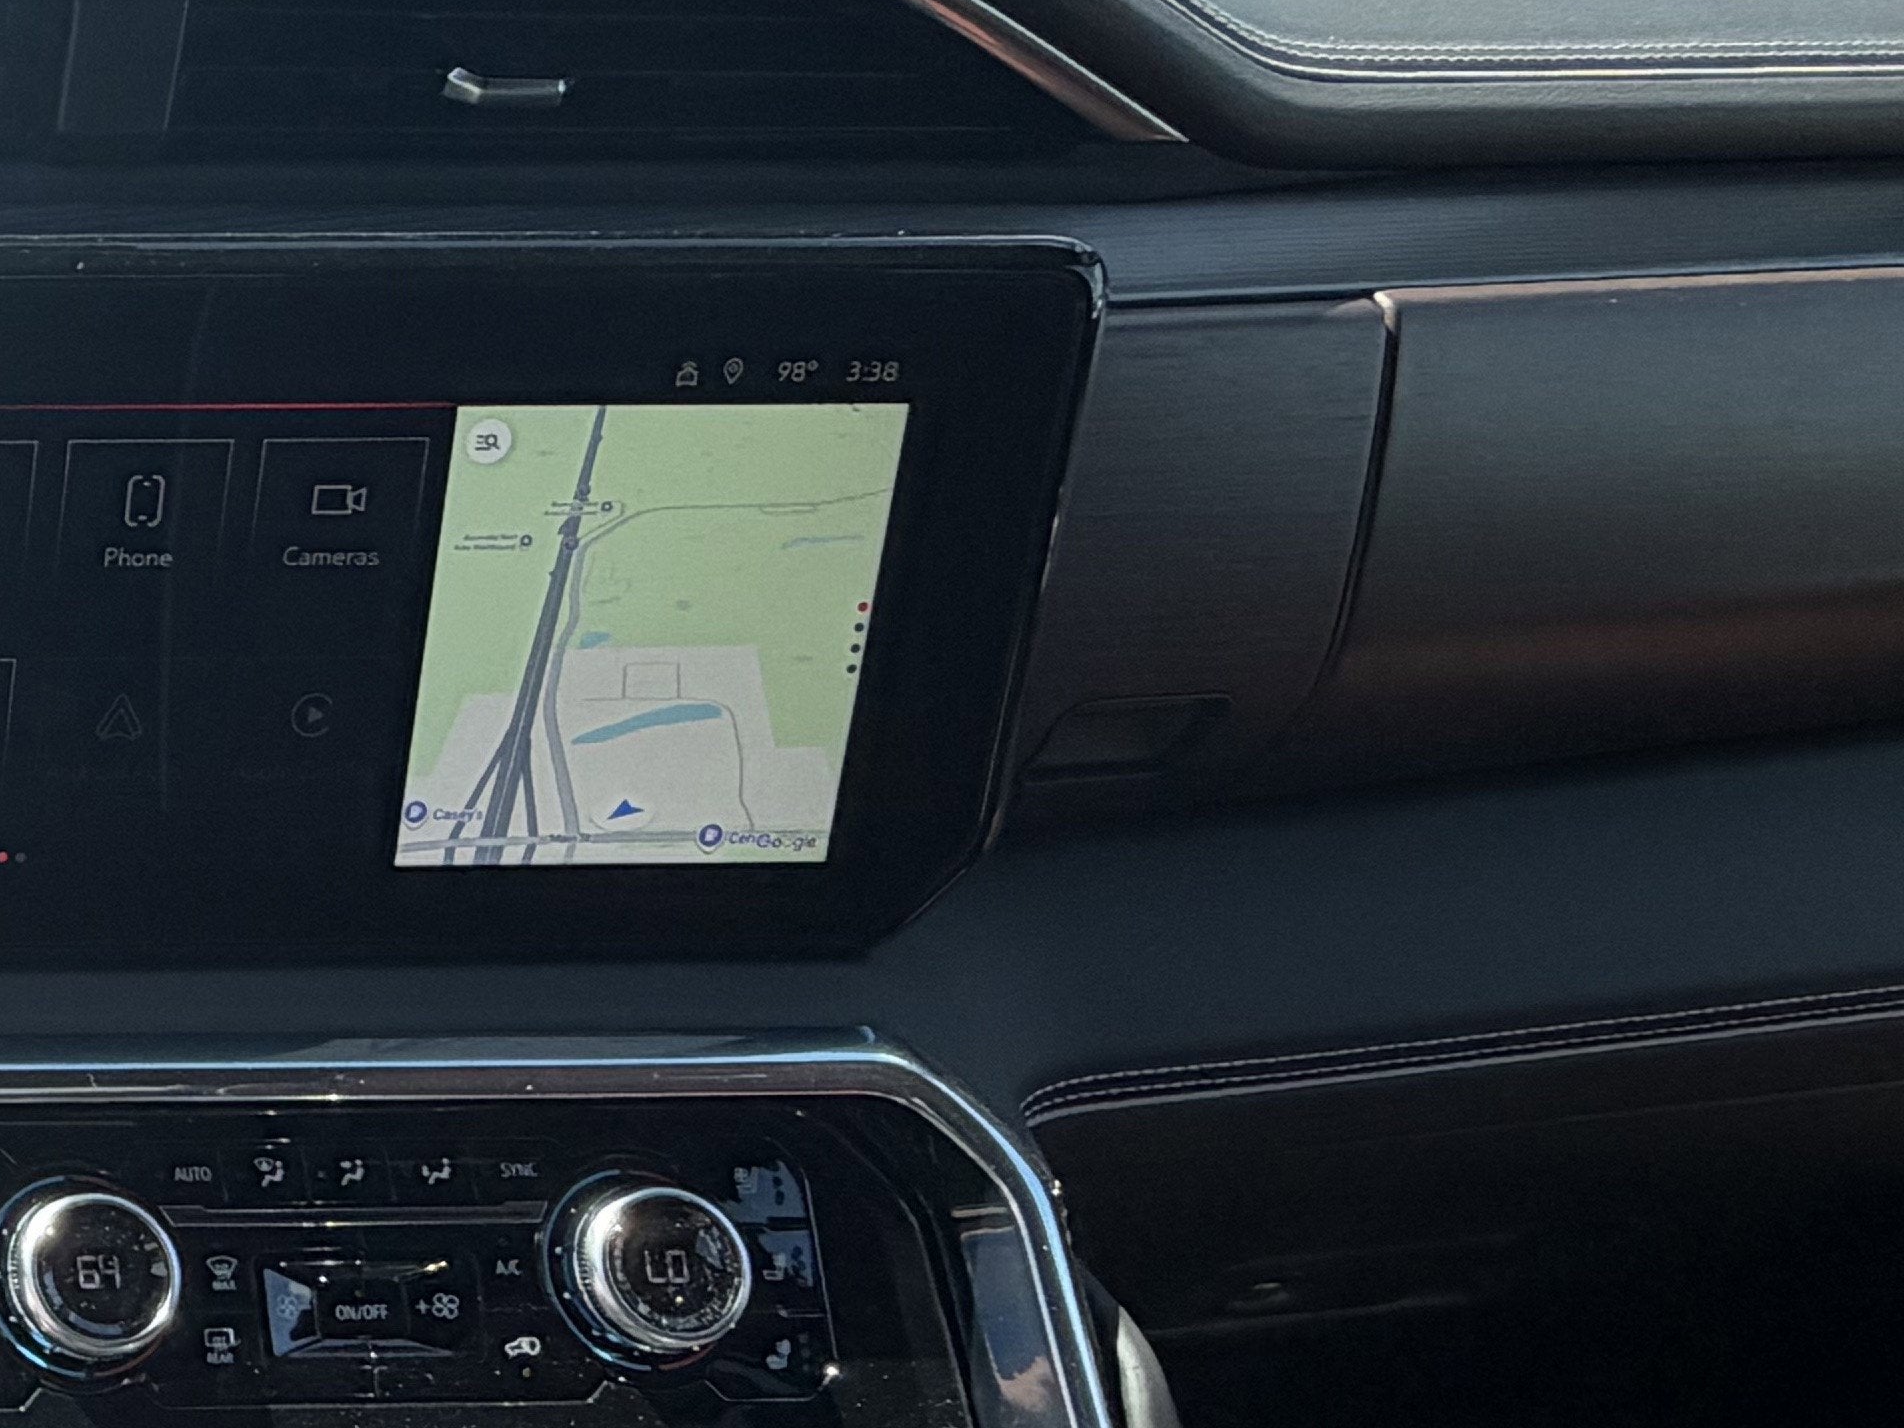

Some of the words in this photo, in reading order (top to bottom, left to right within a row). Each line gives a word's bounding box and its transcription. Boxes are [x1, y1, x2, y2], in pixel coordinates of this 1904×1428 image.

[776, 359, 820, 383] 98°
[845, 360, 901, 383] 3:38
[103, 546, 174, 568] Phone
[283, 546, 381, 568] Cameras
[756, 832, 819, 851] Gogle
[174, 1166, 213, 1182] AUTO
[499, 1161, 538, 1179] SYNC
[76, 1254, 122, 1290] 64
[334, 1303, 389, 1322] ON/OFF
